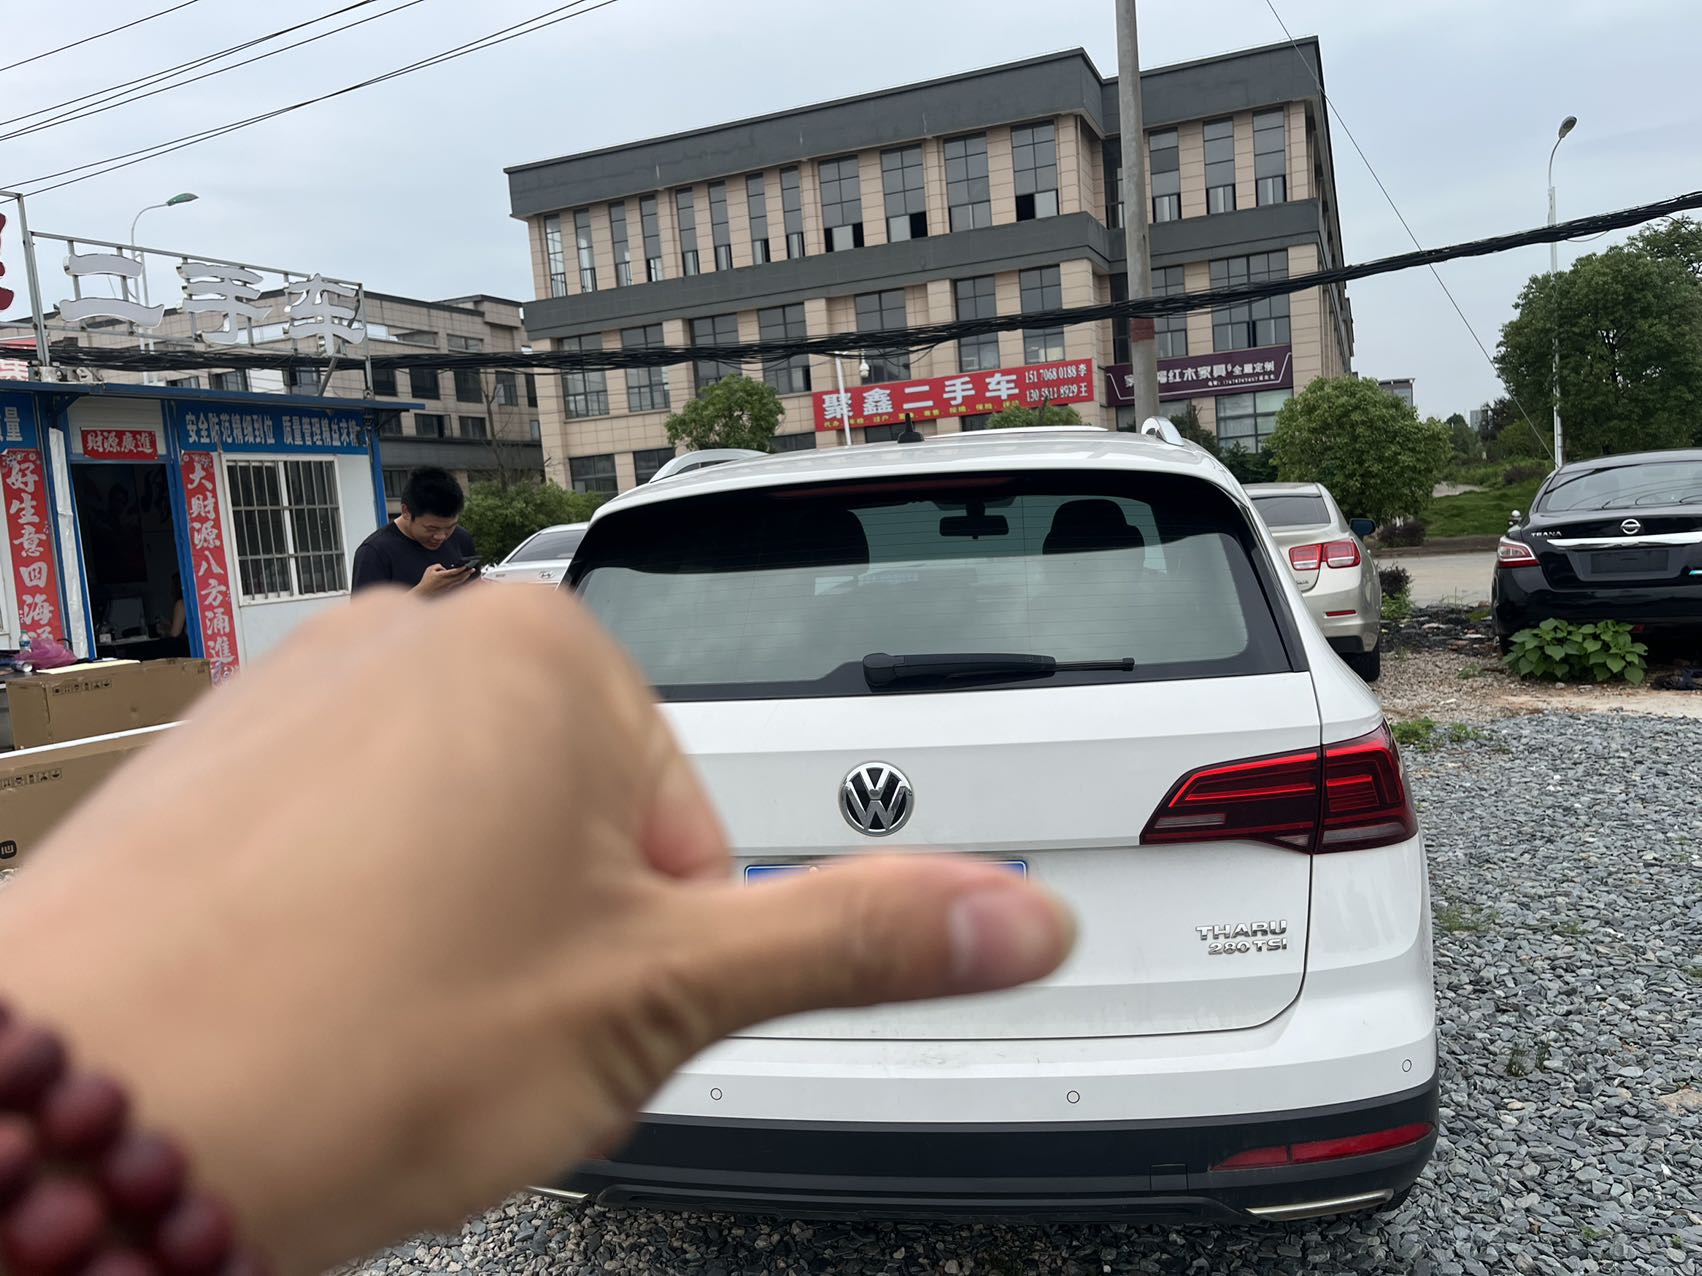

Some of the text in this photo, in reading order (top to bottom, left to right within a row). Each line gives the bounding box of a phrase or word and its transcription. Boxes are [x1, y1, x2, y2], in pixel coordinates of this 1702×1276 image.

[54, 252, 366, 355] 二手车
[1025, 369, 1038, 384] 151
[1232, 360, 1275, 376] 全屋定制
[822, 372, 1020, 419] 聚鑫二手车
[1079, 382, 1088, 397] 王
[1196, 920, 1288, 940] THARU
[1208, 938, 1287, 955] 280 TSI
